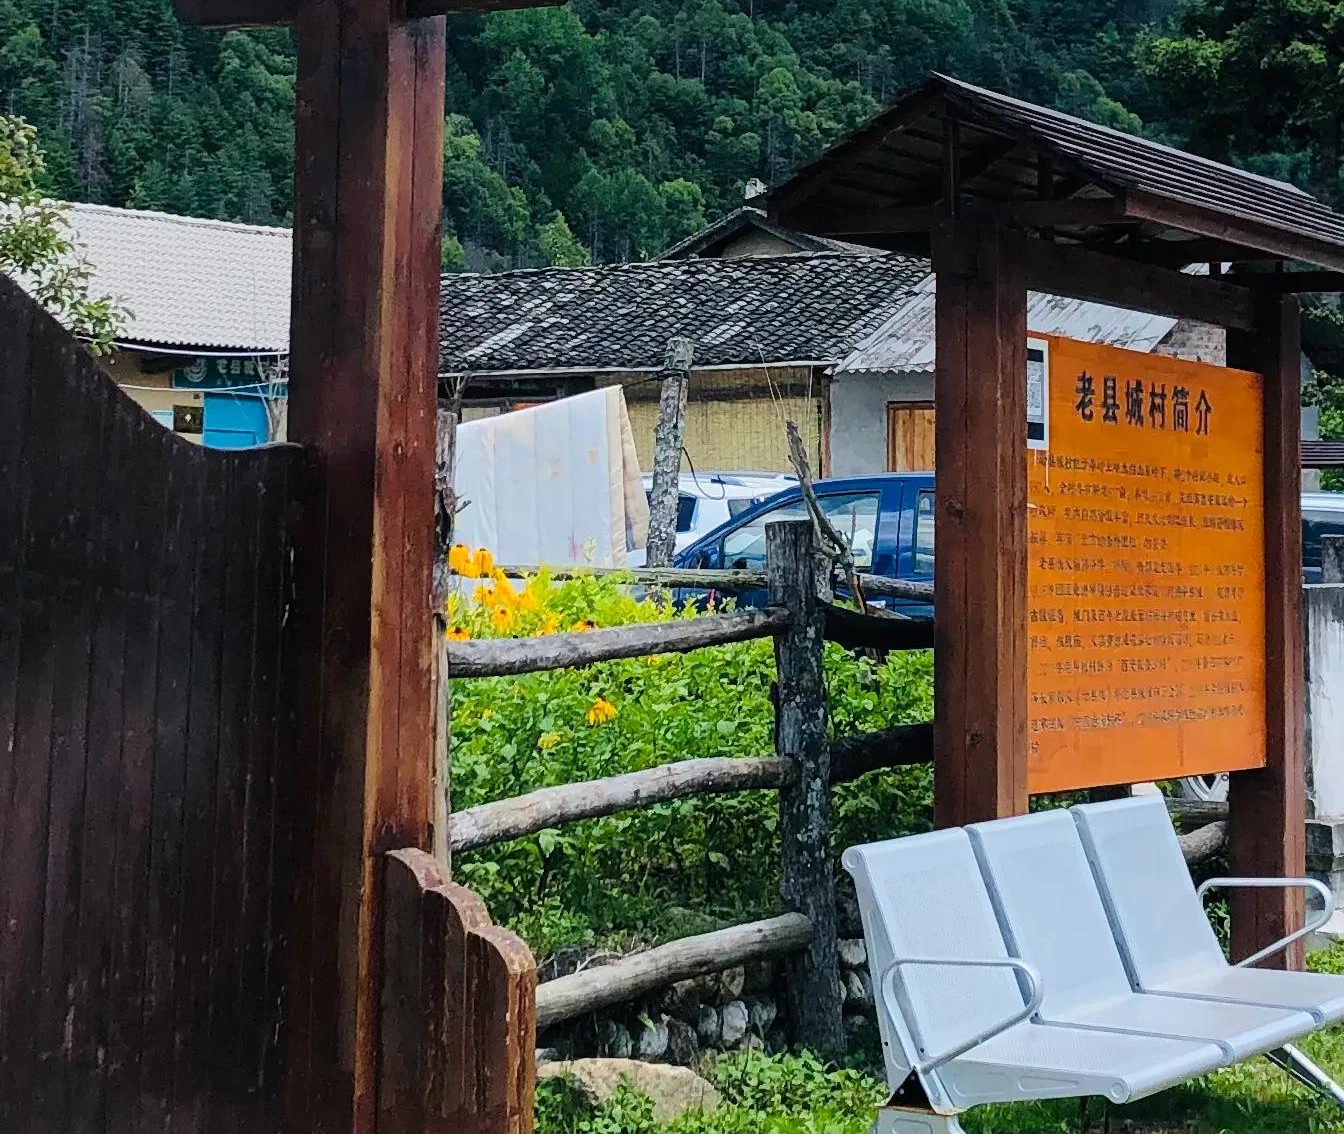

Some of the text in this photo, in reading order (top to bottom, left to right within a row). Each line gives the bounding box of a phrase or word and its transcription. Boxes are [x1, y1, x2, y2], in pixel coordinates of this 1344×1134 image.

[1074, 370, 1213, 436] 老县城村简介
